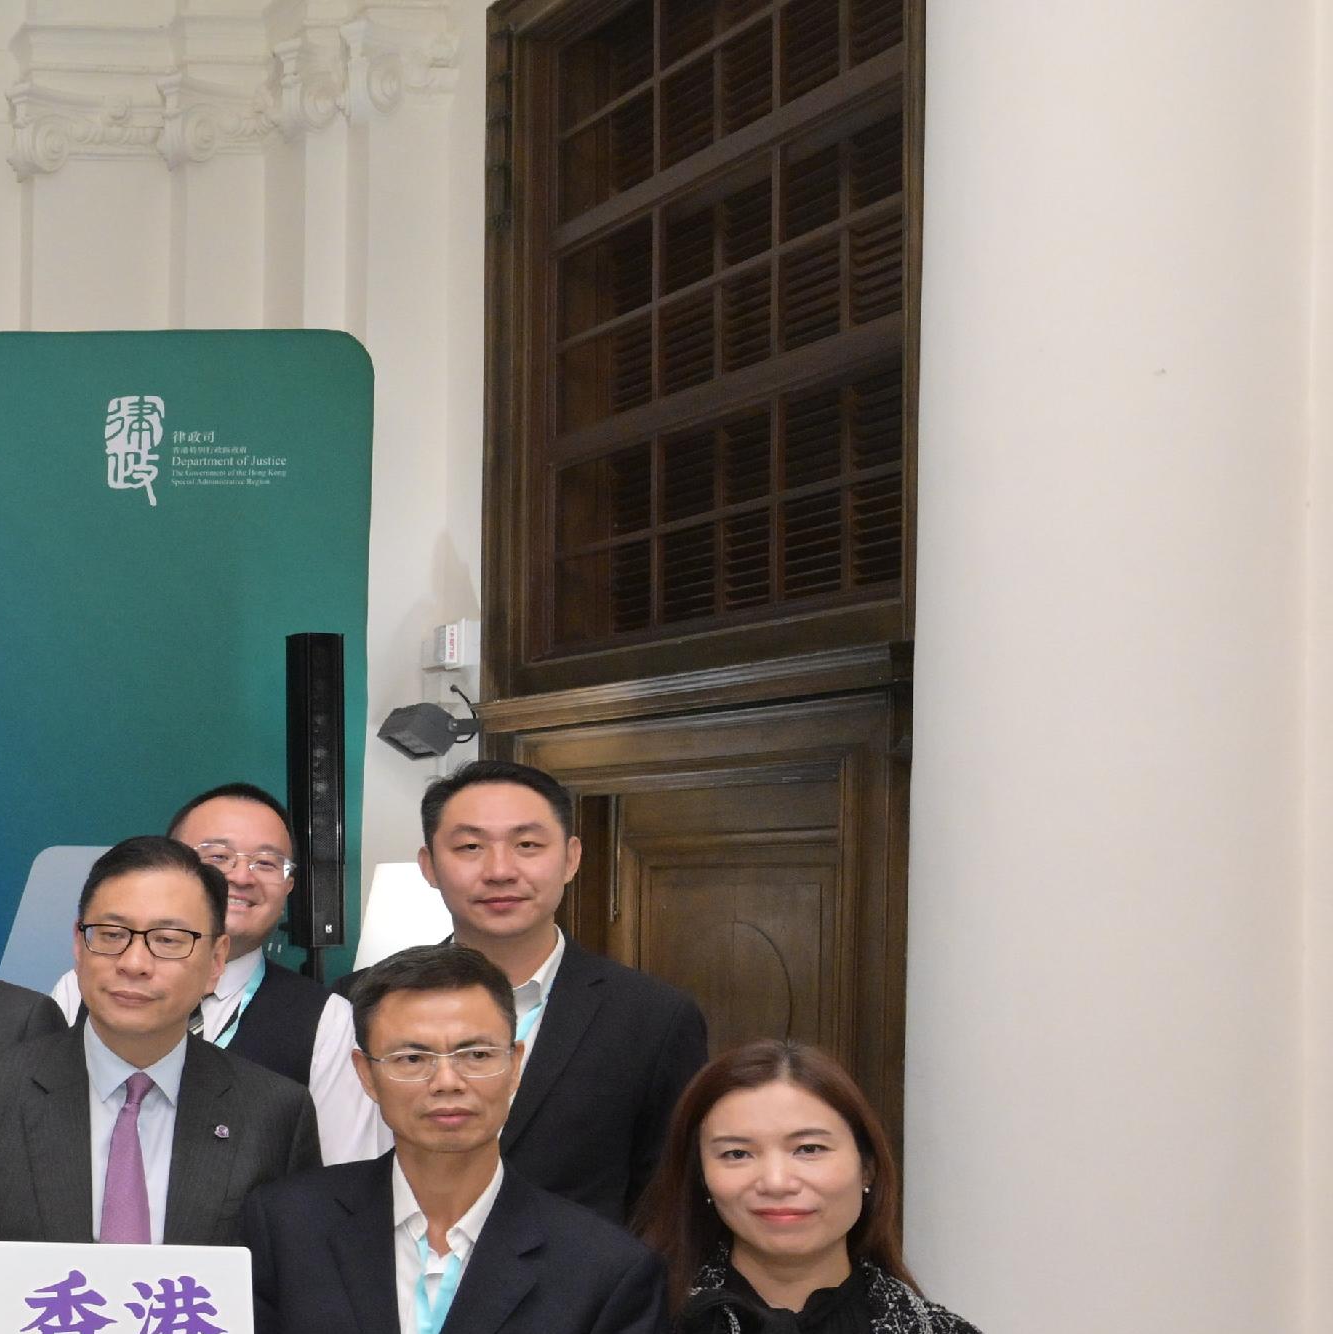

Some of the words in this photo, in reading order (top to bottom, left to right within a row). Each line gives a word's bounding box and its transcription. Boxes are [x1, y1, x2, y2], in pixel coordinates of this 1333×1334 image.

[172, 456, 234, 468] Department
[236, 455, 249, 466] of
[251, 456, 287, 466] Justice
